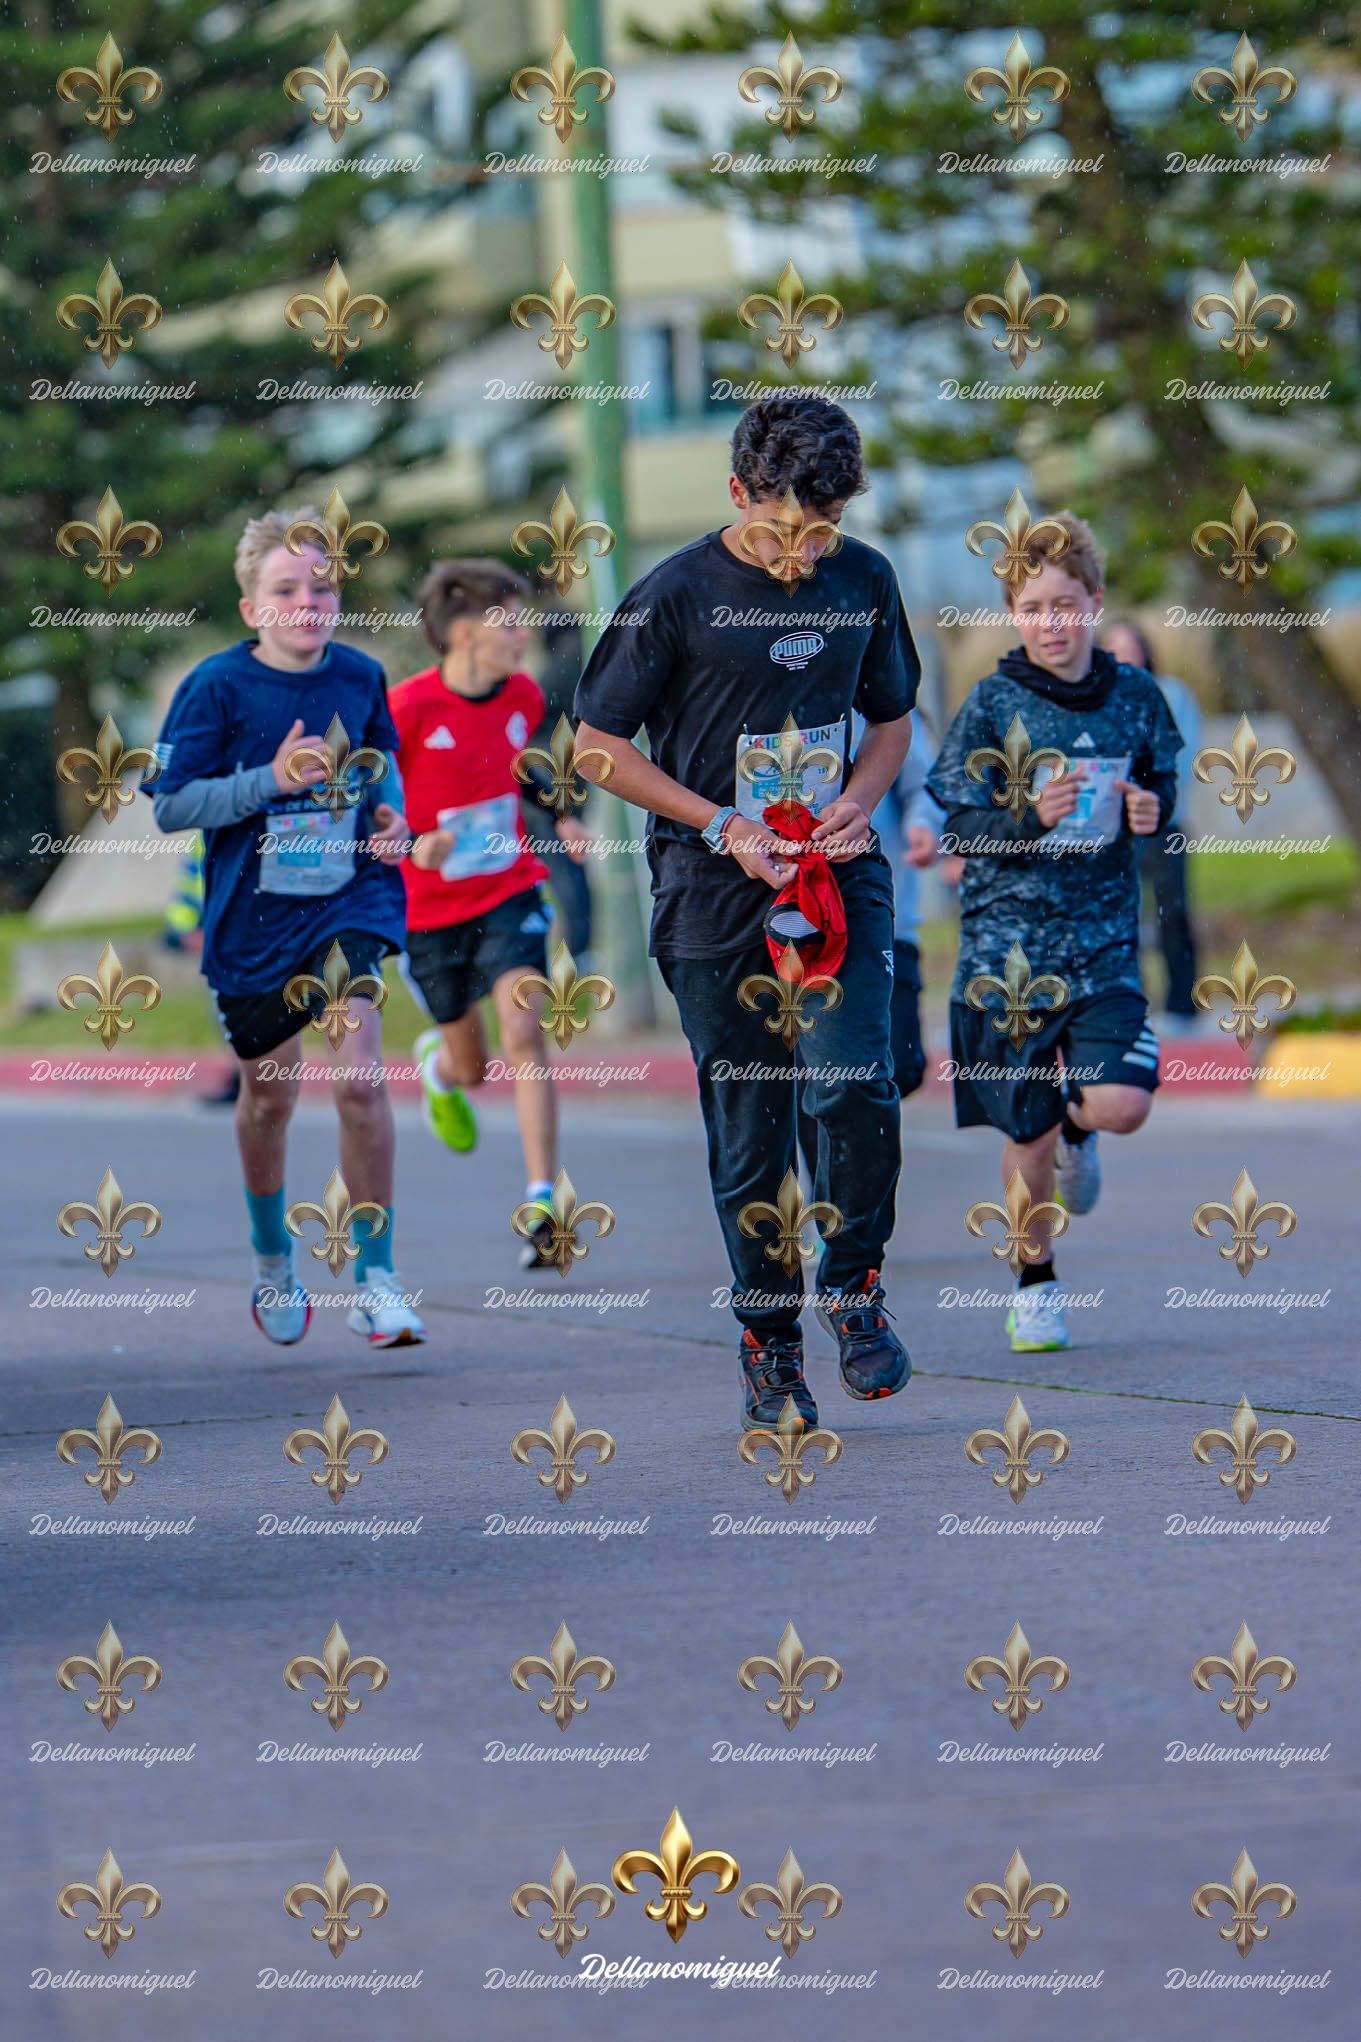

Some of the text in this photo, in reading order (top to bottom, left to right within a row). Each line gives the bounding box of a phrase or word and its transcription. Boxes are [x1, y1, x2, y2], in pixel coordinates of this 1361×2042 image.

[775, 637, 818, 658] PUMA
[754, 728, 831, 750] KIDS RUN
